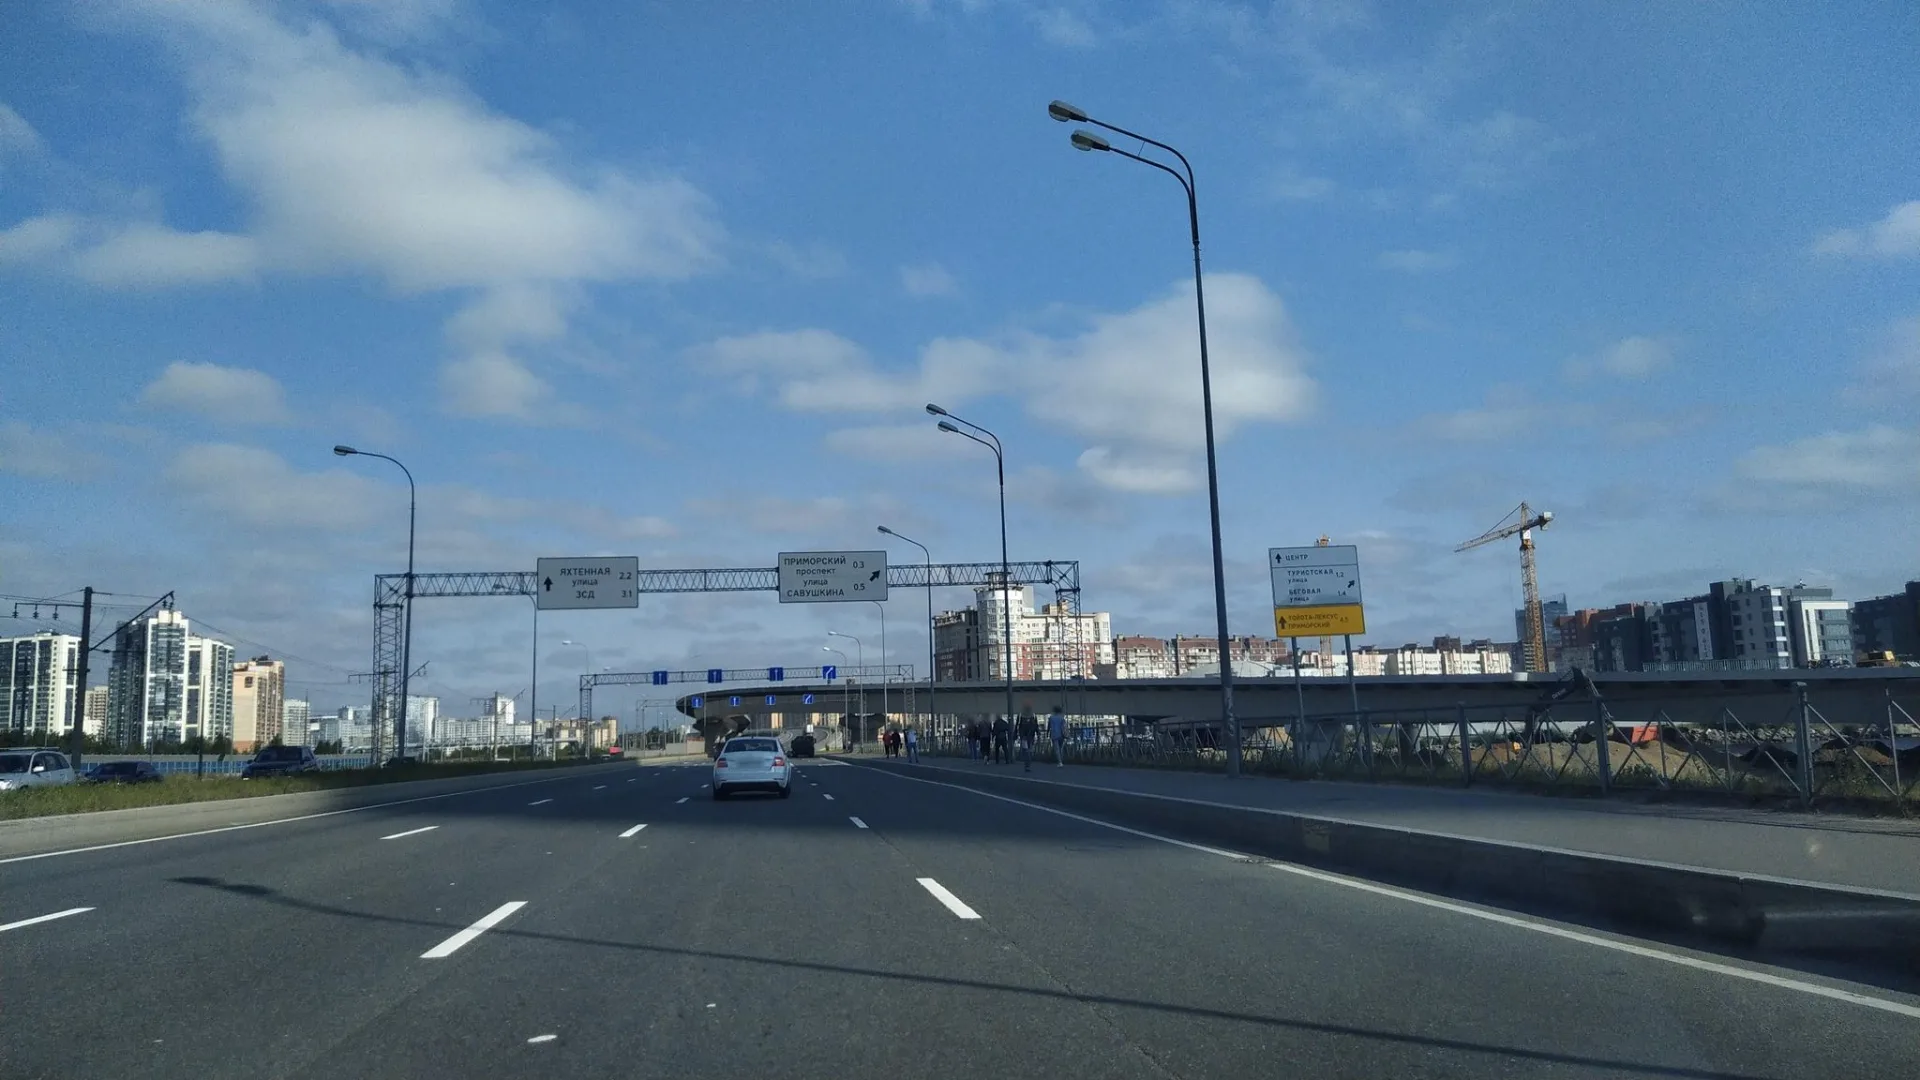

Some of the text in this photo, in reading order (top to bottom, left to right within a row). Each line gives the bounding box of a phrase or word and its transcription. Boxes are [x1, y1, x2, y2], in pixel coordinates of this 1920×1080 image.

[784, 556, 846, 565] ПРИМОРСКИЙ
[560, 567, 610, 576] ЯХТЕННАЯ
[803, 579, 828, 587] улица
[576, 591, 595, 599] ЗСД
[787, 589, 845, 597] САВУШКИНА
